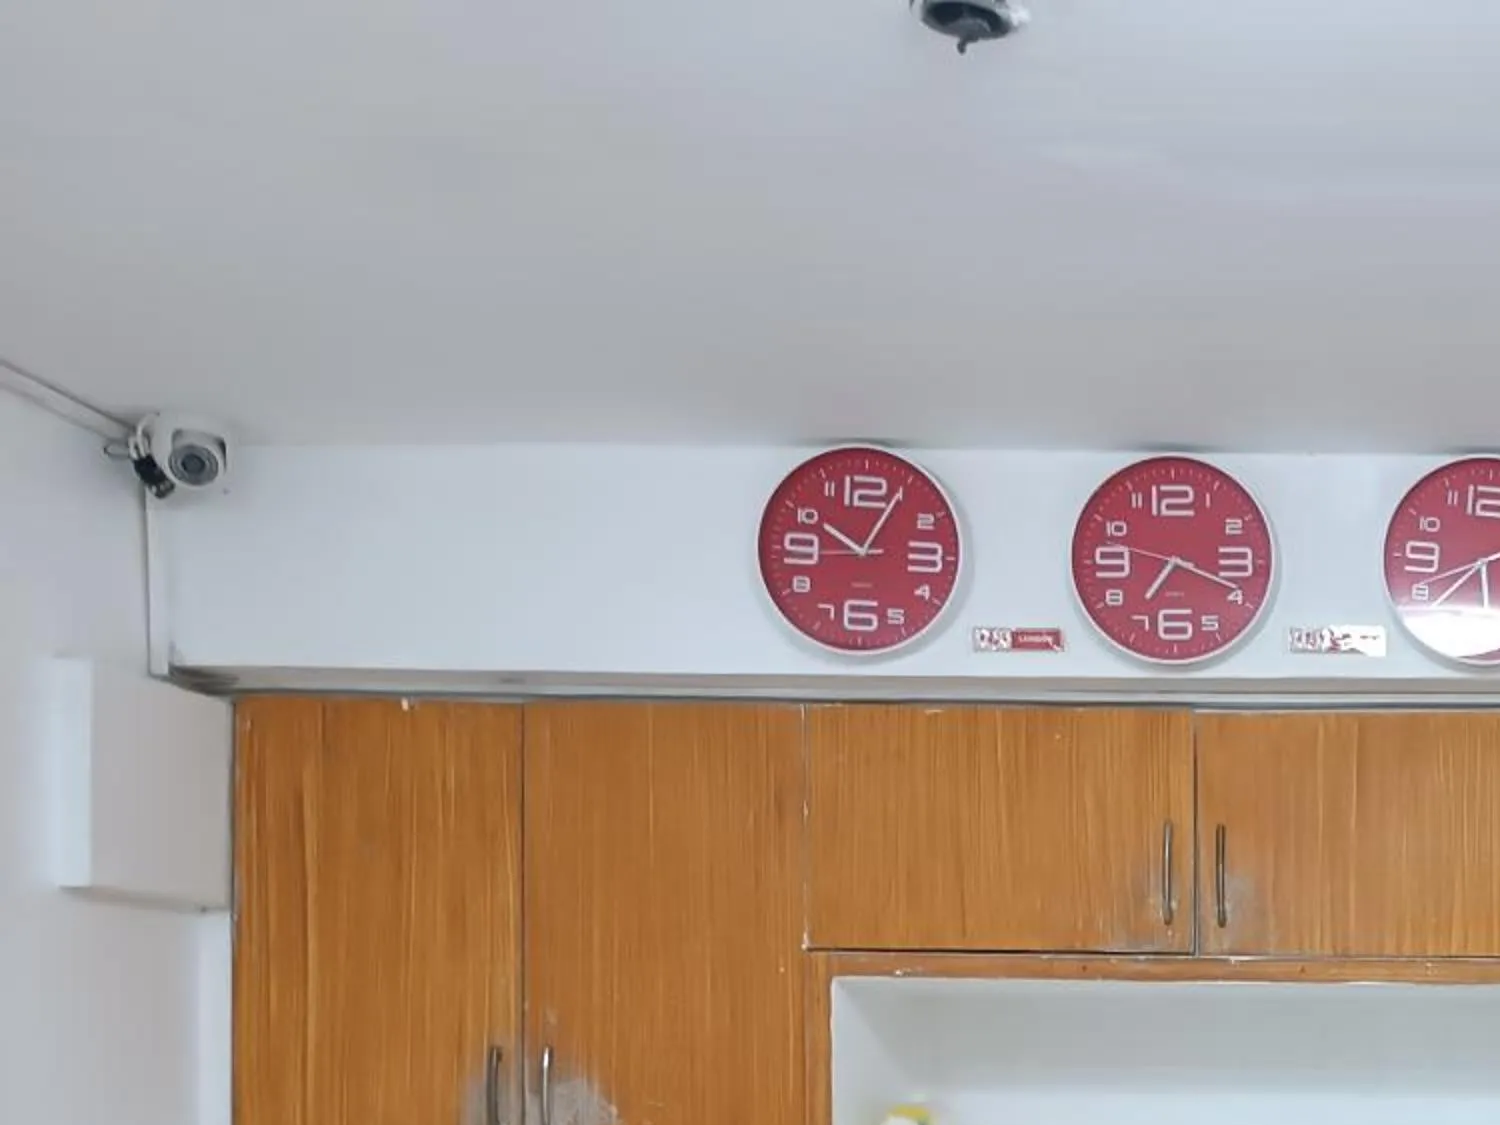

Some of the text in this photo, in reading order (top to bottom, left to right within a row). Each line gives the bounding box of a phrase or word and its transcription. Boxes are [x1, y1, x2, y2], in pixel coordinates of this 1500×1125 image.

[824, 481, 835, 497] 11
[843, 475, 887, 508] 12
[1131, 491, 1143, 508] 11
[1151, 484, 1195, 517] 12
[1447, 490, 1459, 506] 11
[797, 507, 819, 524] 10
[916, 513, 935, 530] 2
[1419, 515, 1441, 532] 10
[1106, 520, 1127, 536] 10
[1224, 518, 1243, 535] 2
[783, 532, 819, 565] 9
[907, 540, 943, 573] 3
[1404, 540, 1440, 573] 9
[1095, 546, 1131, 578] 9
[1217, 546, 1253, 578] 3
[792, 575, 811, 593] 8
[914, 584, 930, 600] 4
[1105, 589, 1123, 606] 8
[1227, 589, 1243, 605] 4
[817, 603, 835, 620] 7
[843, 599, 879, 631] 6
[887, 608, 905, 625] 5
[1131, 614, 1149, 631] 7
[1157, 608, 1193, 641] 6
[1201, 615, 1220, 631] 5
